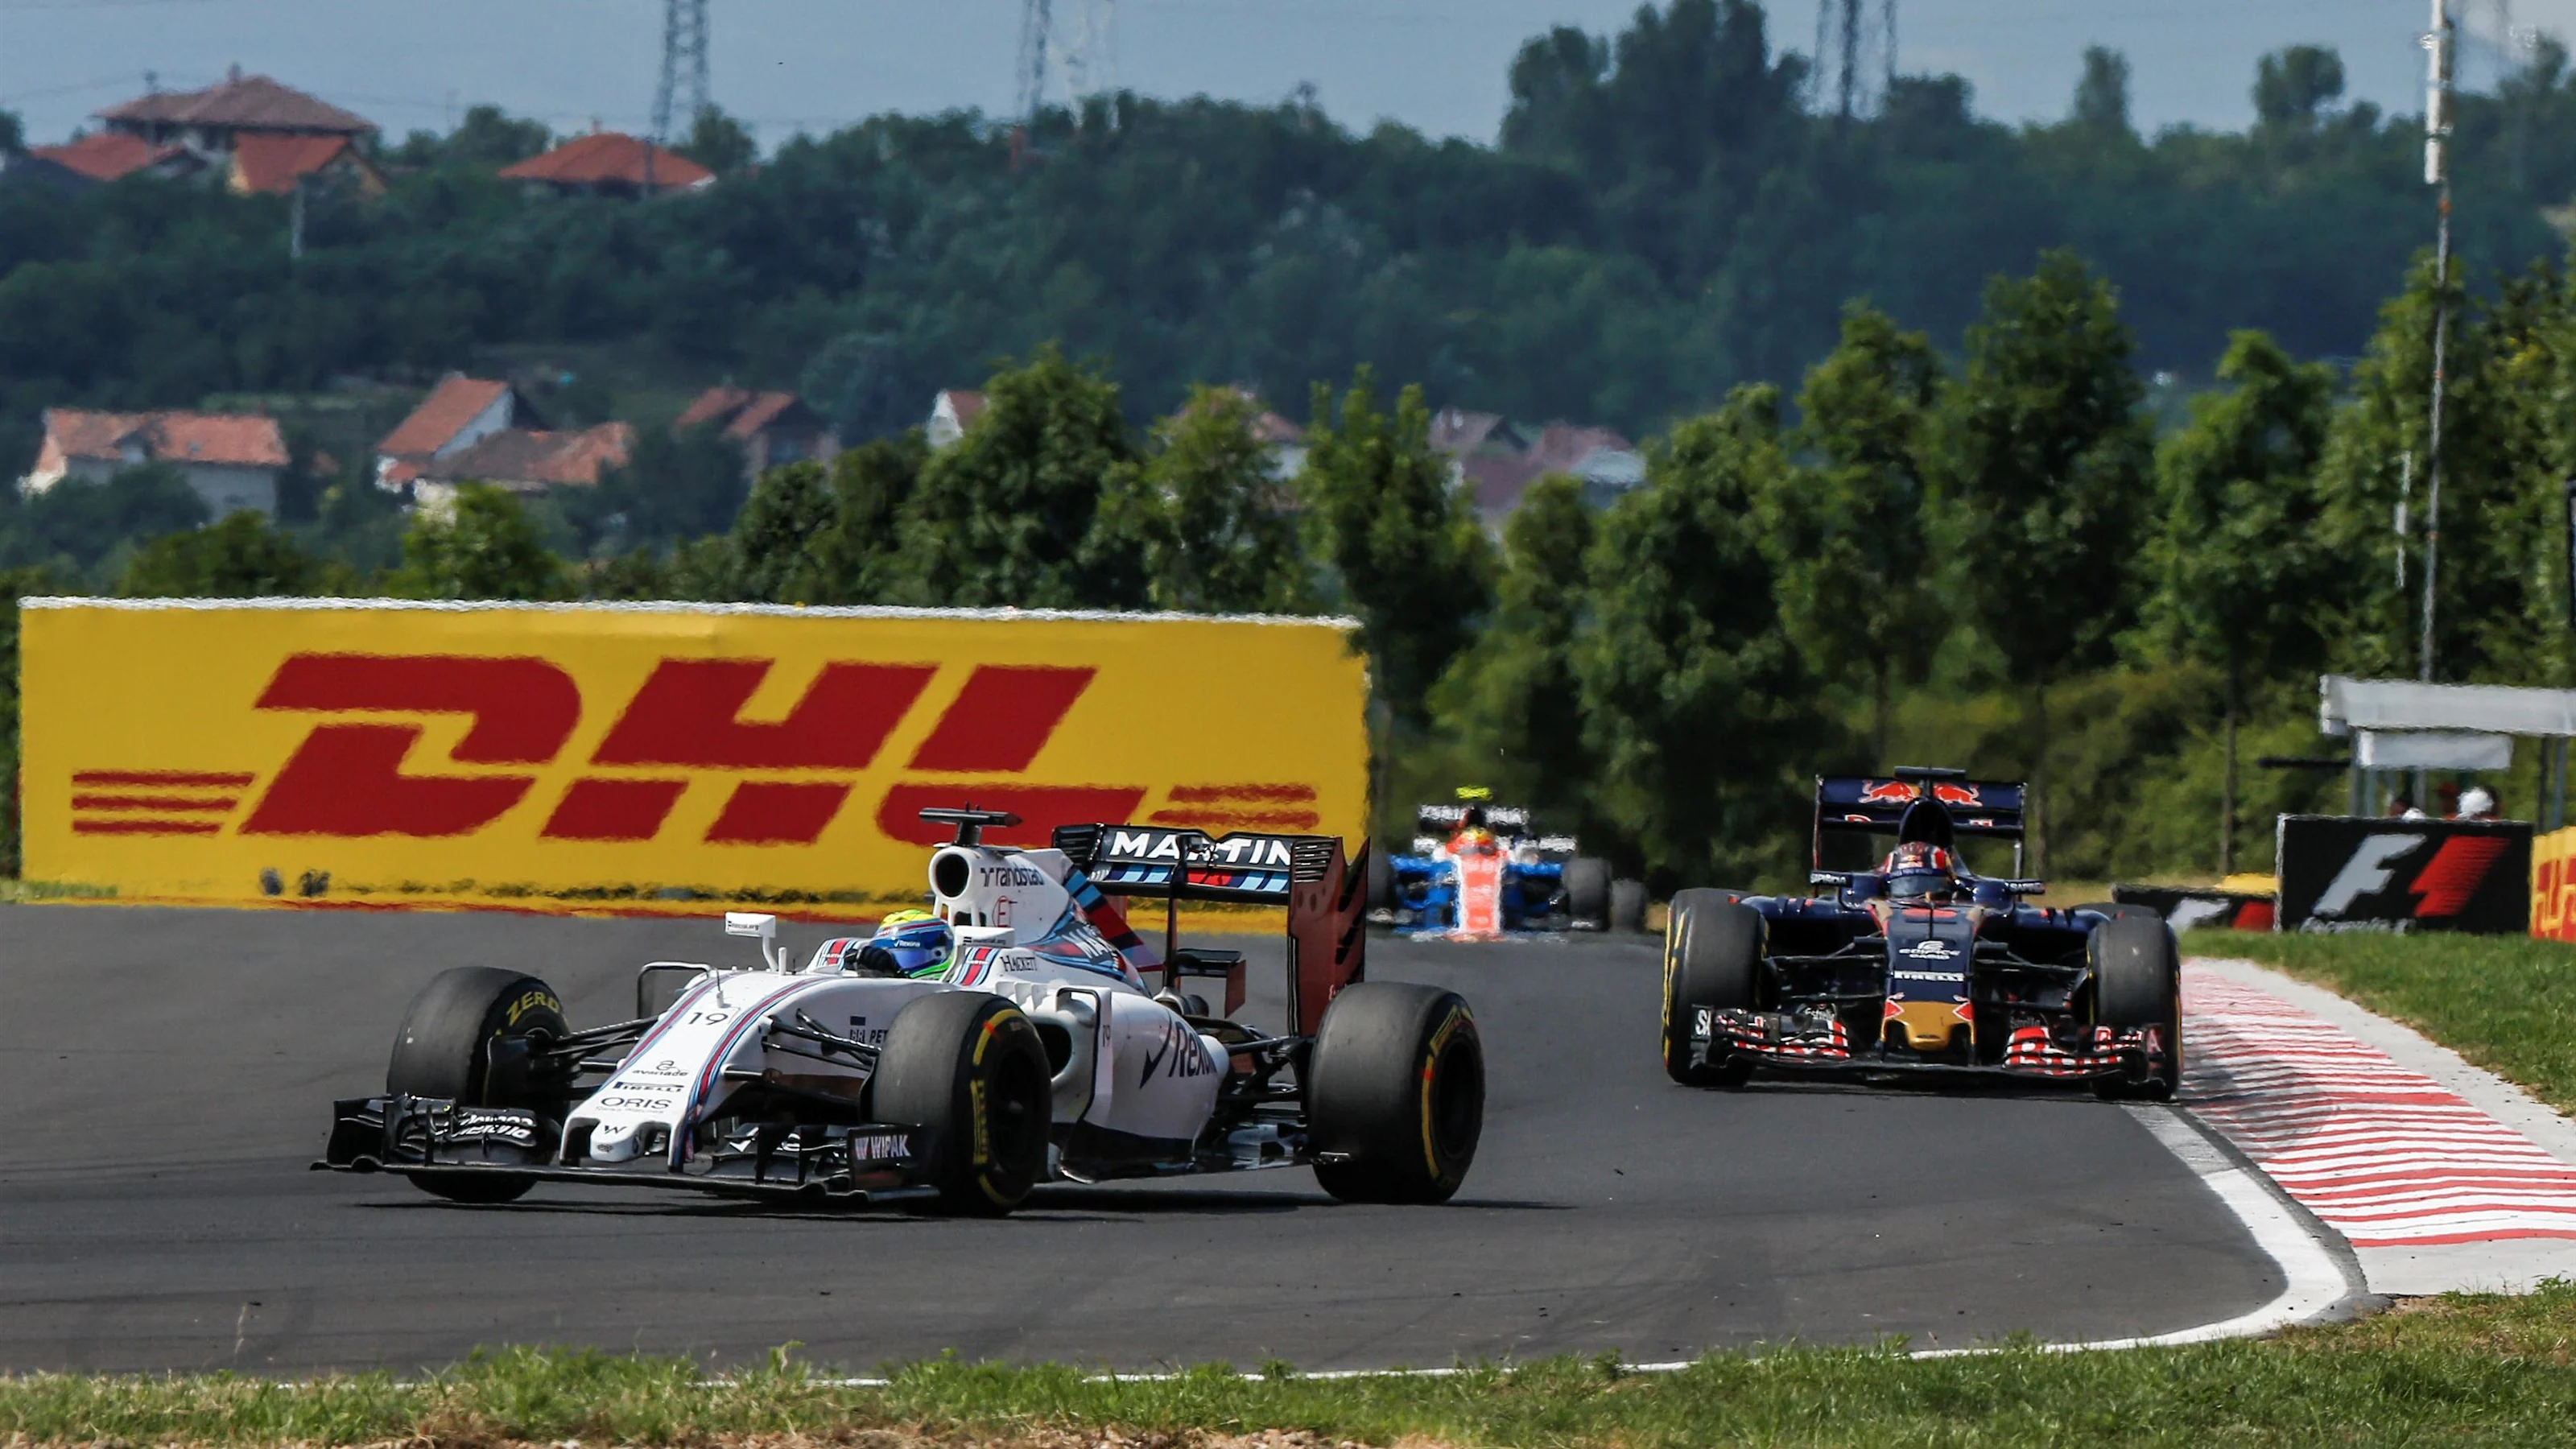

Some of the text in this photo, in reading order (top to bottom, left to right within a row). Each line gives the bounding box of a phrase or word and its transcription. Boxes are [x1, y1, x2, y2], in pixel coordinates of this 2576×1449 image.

[235, 652, 1147, 849] DHL
[996, 863, 1044, 887] randstad
[687, 1012, 729, 1026] 19
[601, 1097, 672, 1109] ORIS
[870, 1135, 911, 1159] WIPAK
